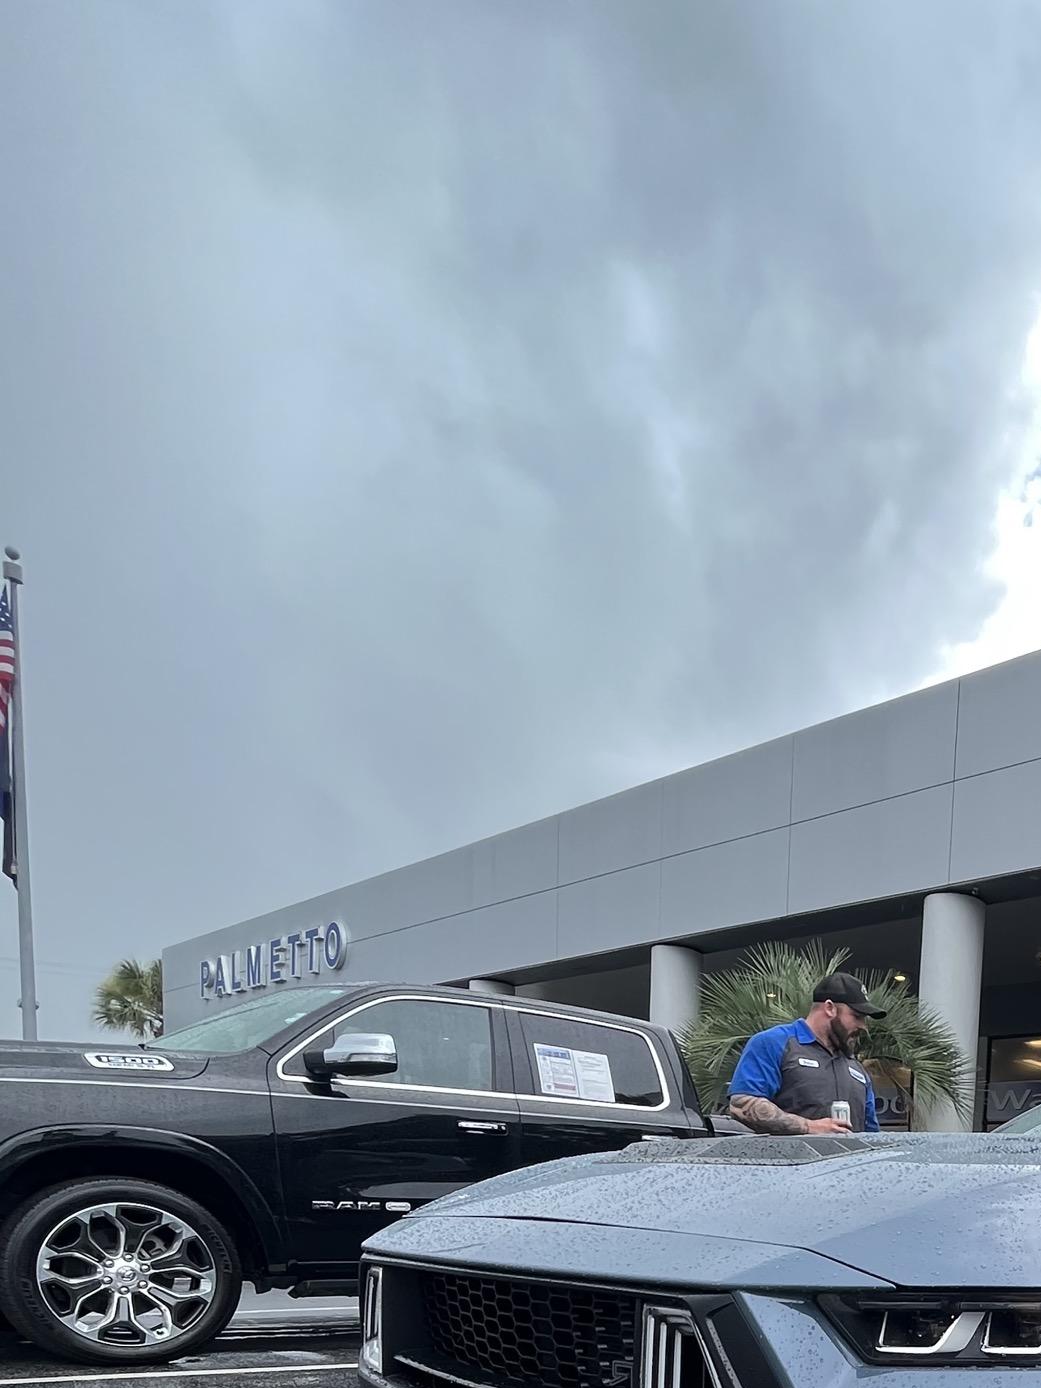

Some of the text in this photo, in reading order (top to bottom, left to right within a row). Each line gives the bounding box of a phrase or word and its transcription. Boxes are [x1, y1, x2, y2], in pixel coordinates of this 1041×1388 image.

[200, 920, 347, 999] PALMETTO
[95, 1054, 165, 1066] 1500
[312, 1200, 381, 1210] RAM
